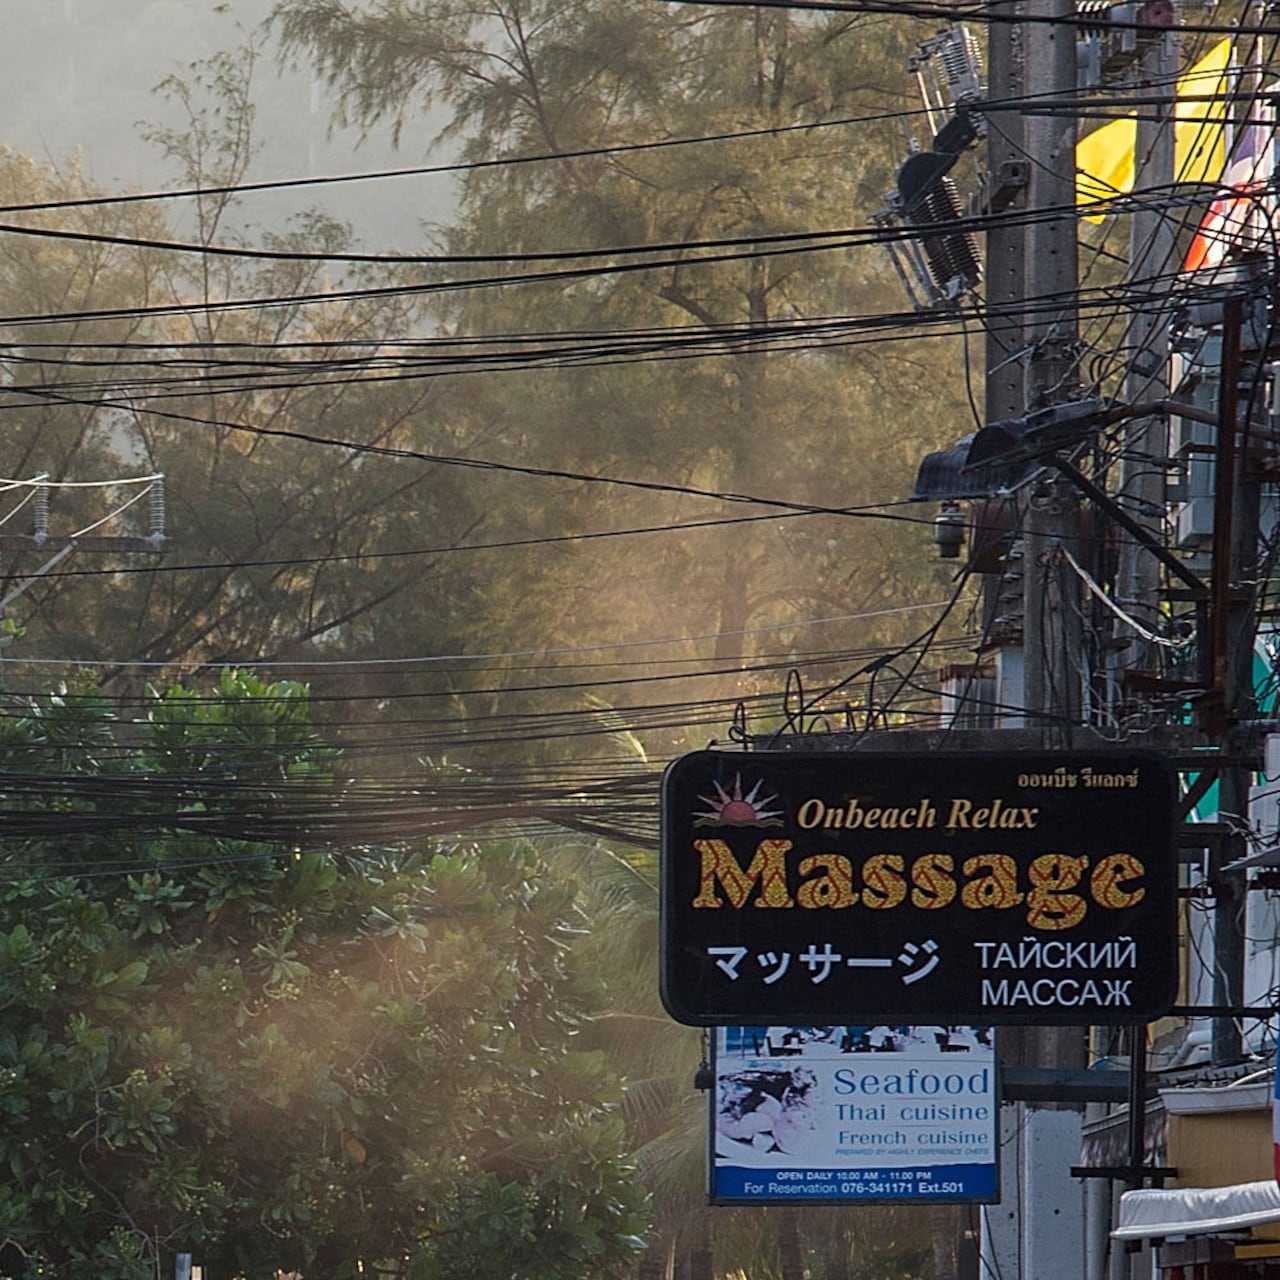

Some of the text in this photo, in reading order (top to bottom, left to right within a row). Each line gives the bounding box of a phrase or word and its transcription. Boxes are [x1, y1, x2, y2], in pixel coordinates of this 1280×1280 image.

[797, 798, 1039, 831] Onbeach Relax
[691, 838, 1146, 931] Massage
[707, 938, 941, 987] マッサージ
[974, 936, 1137, 970] ТАЙСКИЙ
[981, 978, 1132, 1007] МАССАЖ
[834, 1067, 989, 1096] Seafood
[835, 1103, 989, 1121] Thai cuisine
[839, 1131, 989, 1145] French cuisine
[744, 1182, 965, 1194] For Reservation 076-341171 Ext.501
[776, 1171, 804, 1181] OPEN
[806, 1171, 833, 1181] DAILY
[863, 1171, 879, 1181] AM
[916, 1171, 932, 1181] PM
